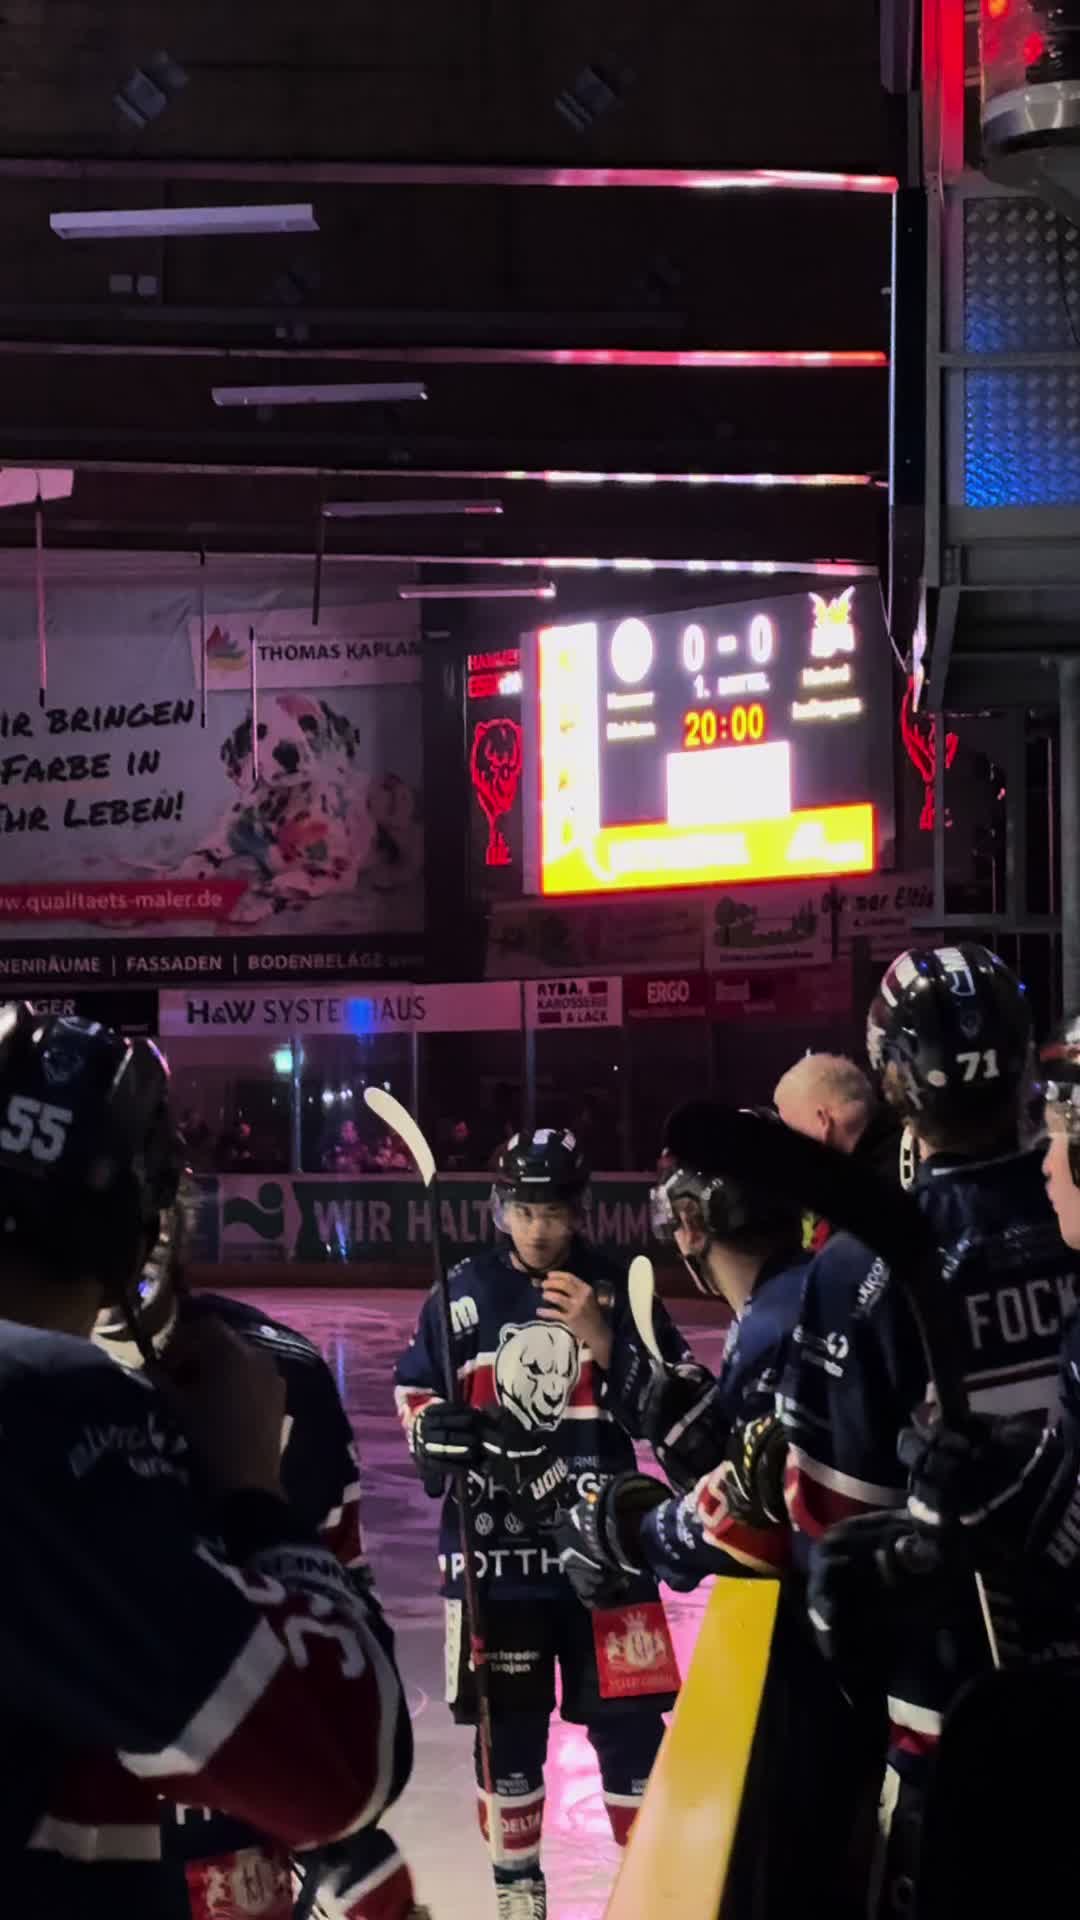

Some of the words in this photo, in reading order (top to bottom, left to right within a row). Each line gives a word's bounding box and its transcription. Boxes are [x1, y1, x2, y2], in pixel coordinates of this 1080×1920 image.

[258, 643, 340, 661] THOMAS
[683, 624, 706, 672] 0
[750, 615, 773, 664] 0
[46, 698, 194, 735] BRINGEN
[685, 703, 764, 747] 20:00
[0, 753, 111, 786] FARBE
[127, 749, 160, 776] IN
[63, 790, 184, 828] LEBEN!
[127, 954, 223, 972] FASSADEN
[248, 951, 384, 970] BODENBELÄGE
[647, 980, 690, 1004] ERGO
[187, 1001, 255, 1024] H&W
[577, 1011, 609, 1023] LACK
[956, 1049, 1000, 1082] 71
[1, 1096, 73, 1161] 55
[313, 1200, 392, 1243] WIR
[408, 1199, 497, 1242] HALT
